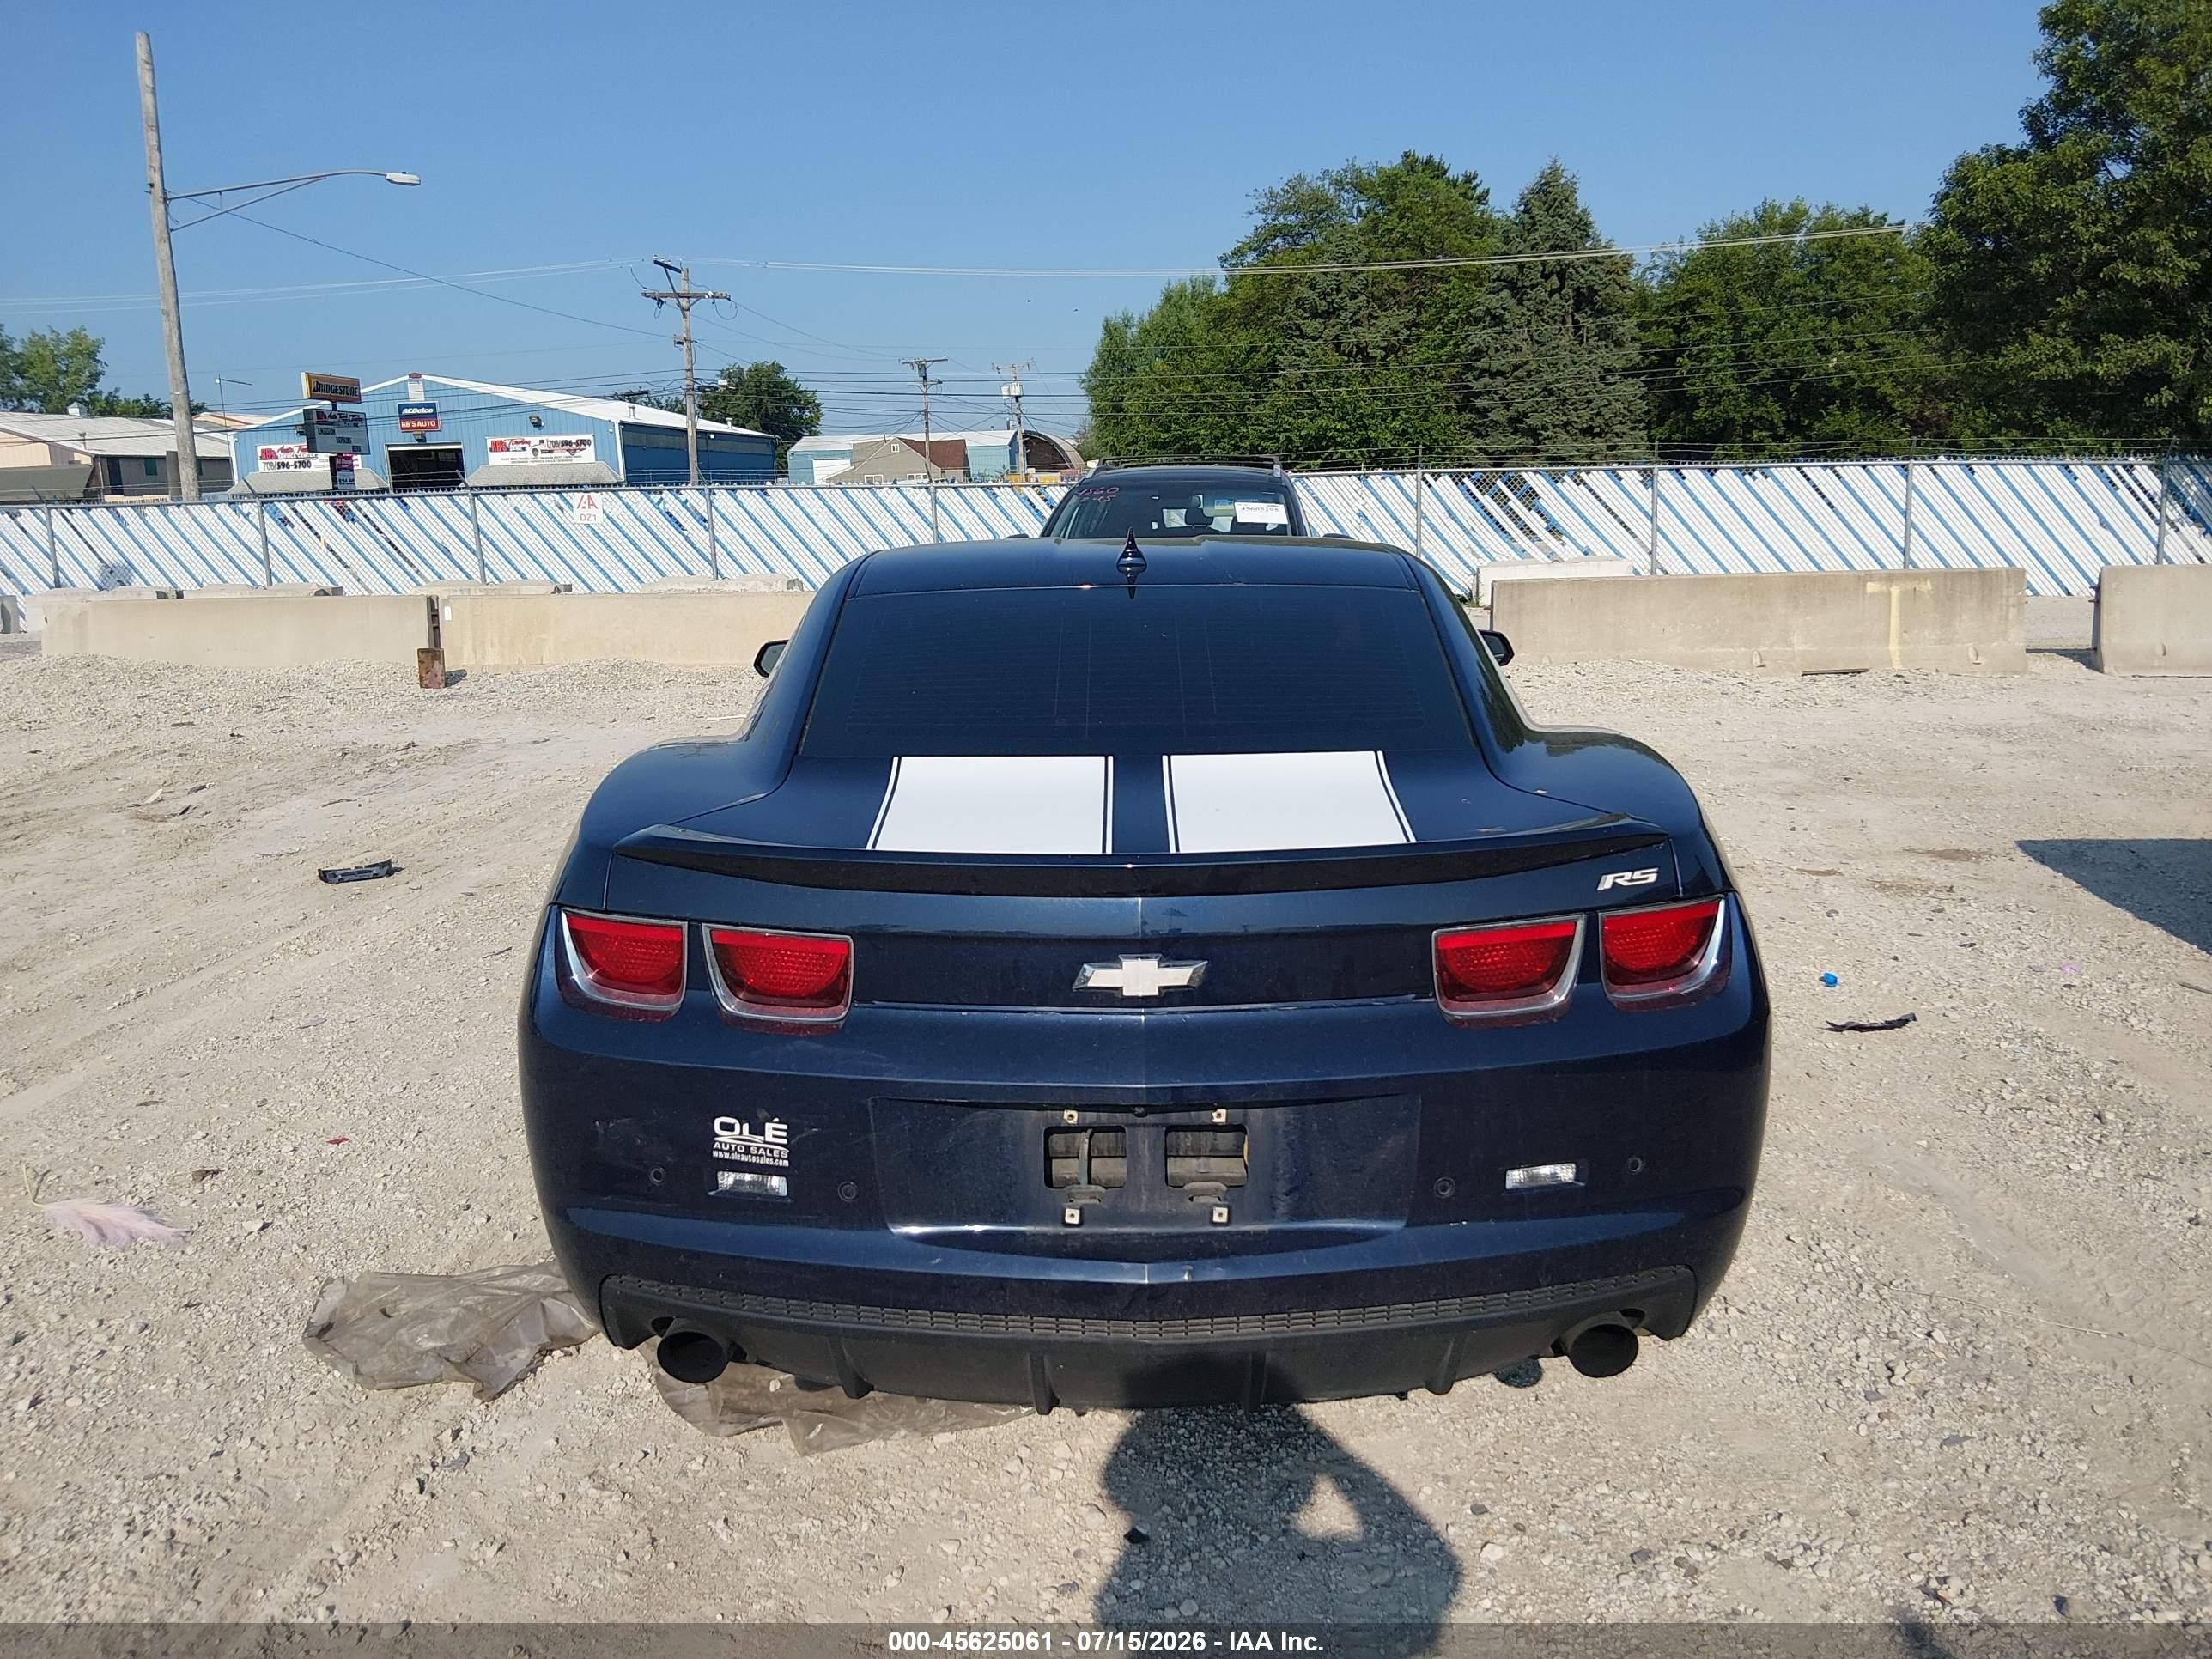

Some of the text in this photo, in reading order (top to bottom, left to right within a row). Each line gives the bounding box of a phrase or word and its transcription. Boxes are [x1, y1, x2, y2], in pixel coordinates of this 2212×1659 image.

[312, 380, 358, 397] BRIDGESTONE
[507, 438, 532, 447] Towing
[1597, 867, 1659, 890] RS
[713, 1141, 788, 1158] AUTO SALES
[712, 1150, 789, 1167] www.oleautosales.com
